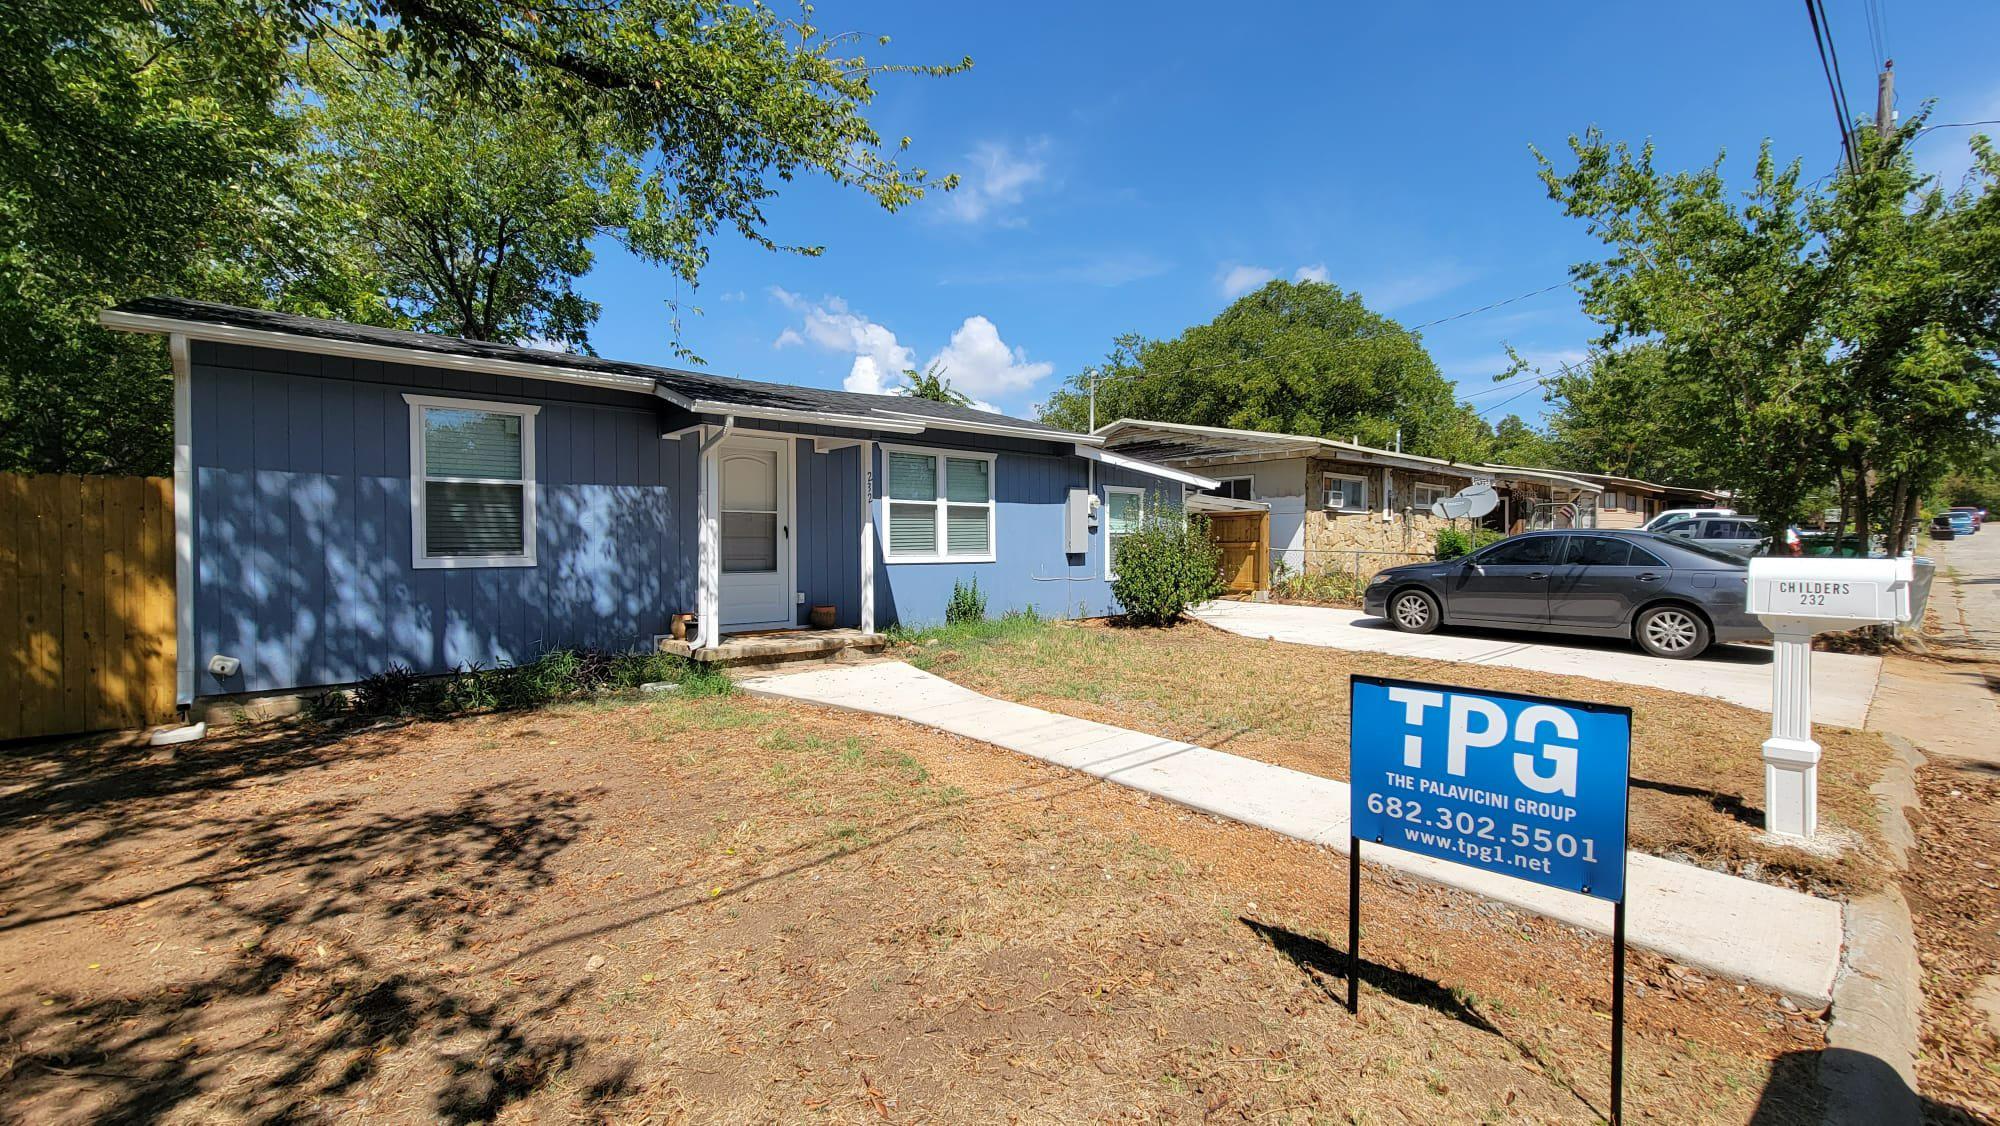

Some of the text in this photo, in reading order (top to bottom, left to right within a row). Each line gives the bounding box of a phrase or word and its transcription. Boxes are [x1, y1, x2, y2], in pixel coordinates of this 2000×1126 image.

[1780, 582, 1850, 594] CHILDERS
[1800, 594, 1825, 606] 232
[1388, 687, 1579, 798] TPG
[1386, 772, 1577, 822] THE PALAVICINI GROUP
[1367, 793, 1598, 863] 682.302.5501
[1405, 828, 1551, 874] www.tpg1.net
